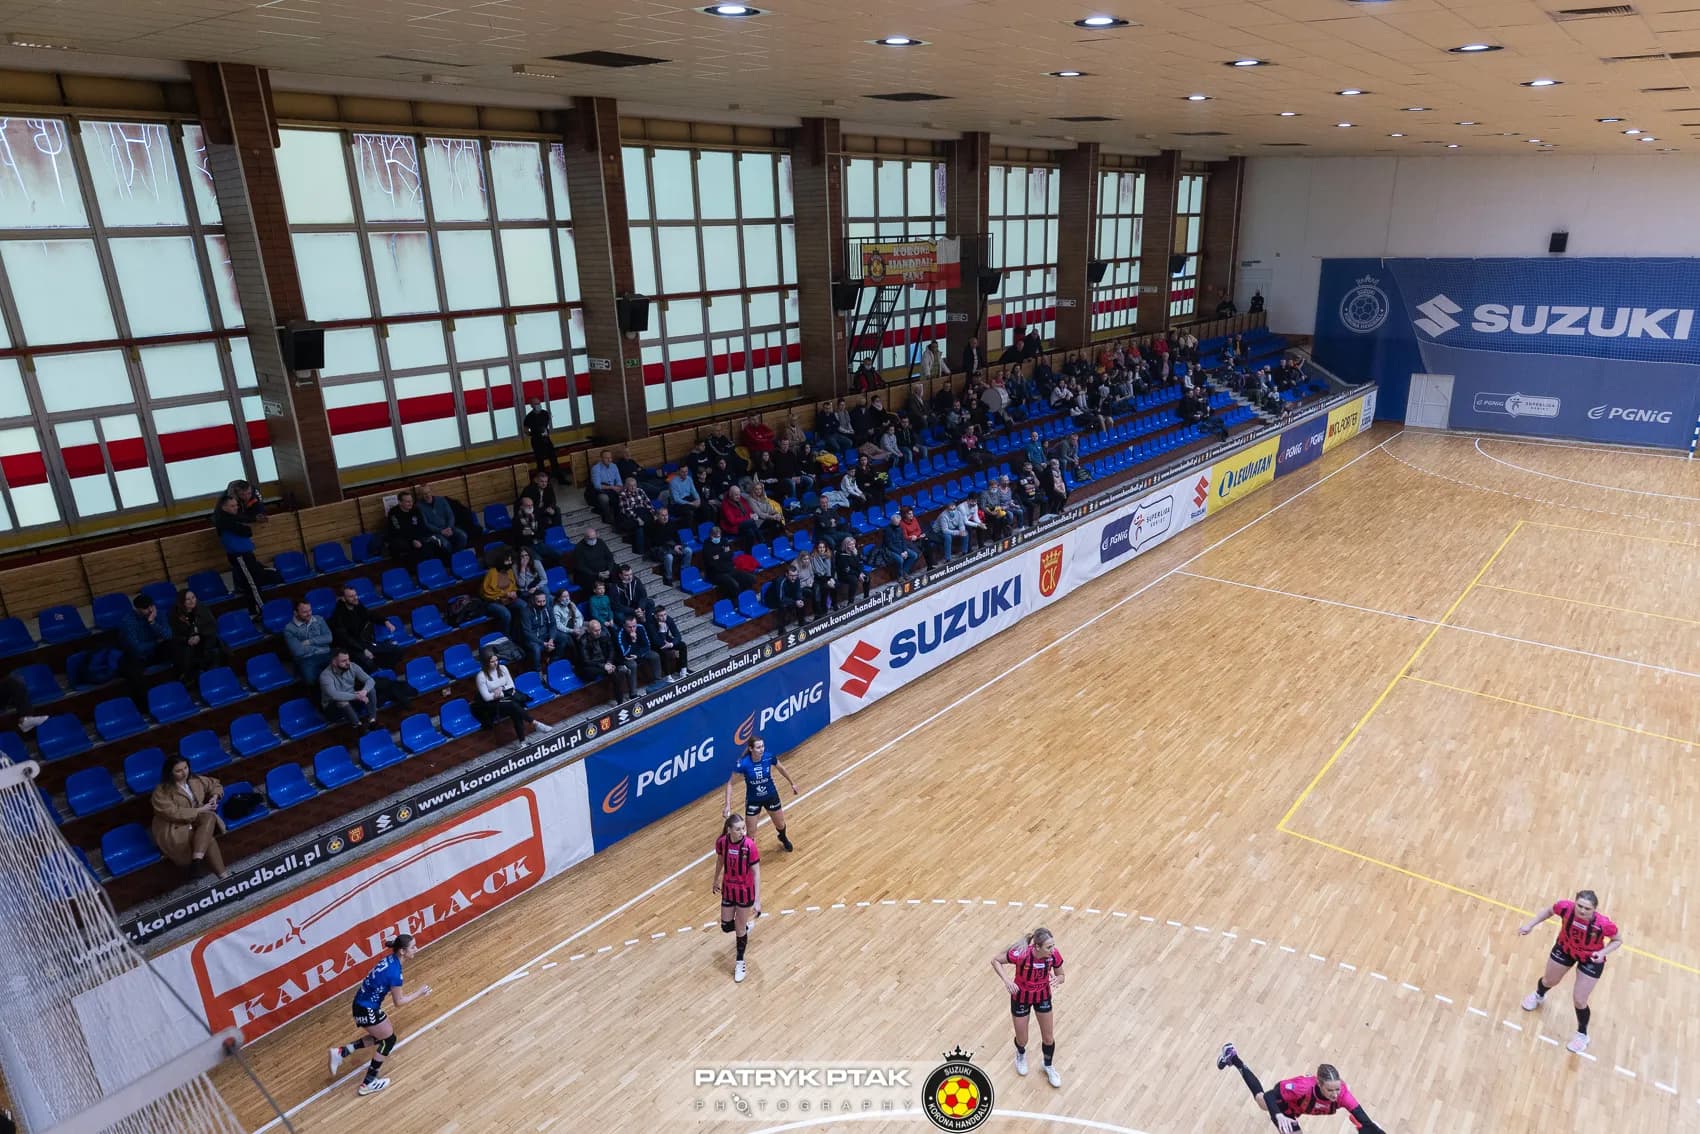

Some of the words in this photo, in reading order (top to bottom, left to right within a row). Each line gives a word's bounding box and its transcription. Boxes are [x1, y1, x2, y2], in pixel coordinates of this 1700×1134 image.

[1472, 303, 1695, 340] SUZUKI
[1608, 407, 1673, 424] PGNiG
[1233, 454, 1272, 487] LEWIATAN
[1109, 529, 1128, 546] PGNiG
[930, 545, 997, 581] www.koronahandball.pl
[1041, 565, 1058, 593] CK
[889, 574, 1021, 669] SUZUKI
[646, 646, 761, 709] www.koronahandball.pl
[759, 681, 824, 732] PGNiG
[418, 730, 582, 811] www.koronahandball.pl
[636, 737, 715, 798] PGNiG
[229, 855, 532, 1028] KARABELA-CK
